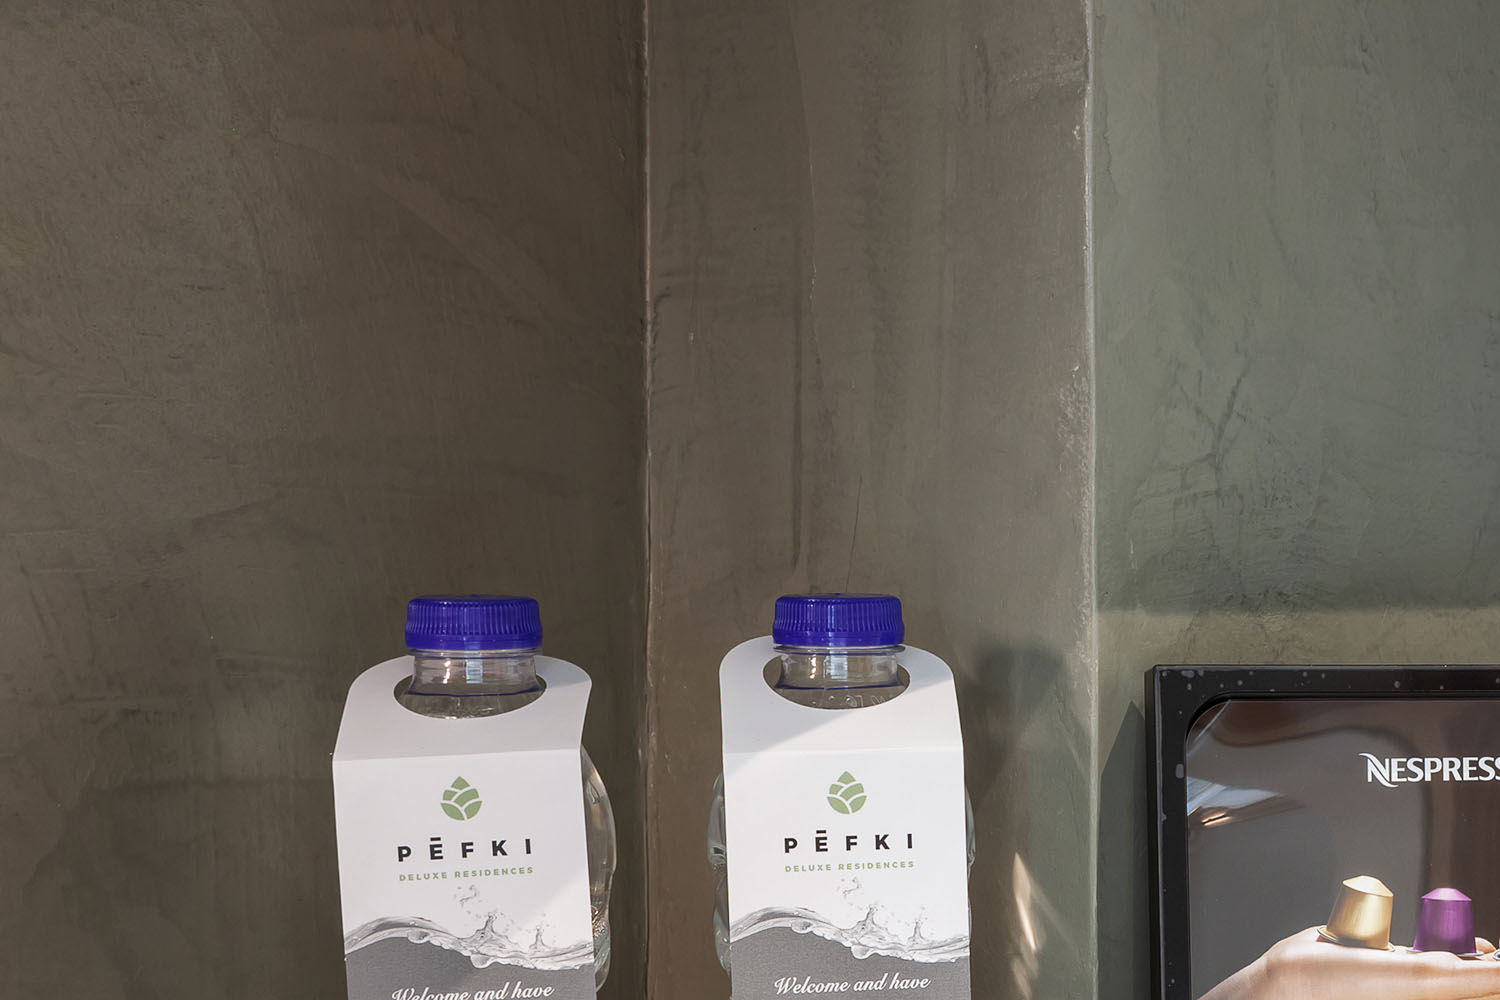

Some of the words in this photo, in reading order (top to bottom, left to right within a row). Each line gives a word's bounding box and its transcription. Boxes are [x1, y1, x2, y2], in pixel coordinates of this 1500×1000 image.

[397, 836, 532, 862] PĒFKI
[784, 829, 913, 854] PĒFKI
[399, 871, 448, 882] DELUXE
[454, 866, 534, 879] RESIDENCES
[784, 864, 832, 873] DELUXE
[838, 861, 915, 871] RESIDENCES
[474, 982, 509, 1000] and
[511, 981, 555, 998] have
[774, 976, 850, 996] Welcome
[853, 973, 888, 992] and
[889, 972, 932, 989] have
